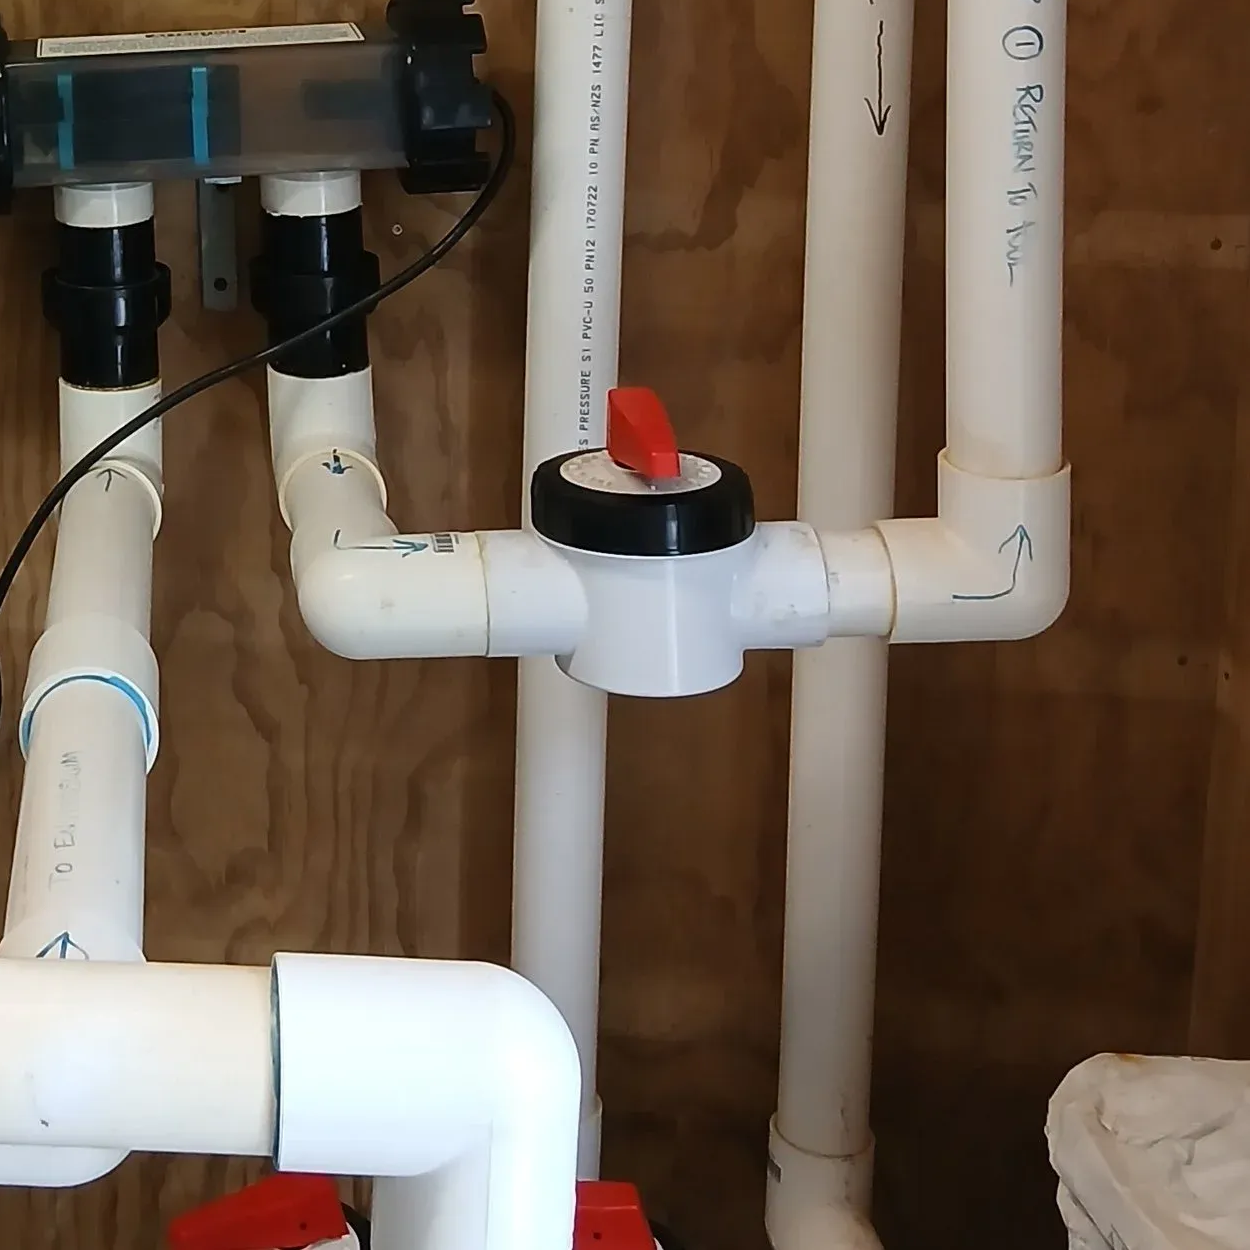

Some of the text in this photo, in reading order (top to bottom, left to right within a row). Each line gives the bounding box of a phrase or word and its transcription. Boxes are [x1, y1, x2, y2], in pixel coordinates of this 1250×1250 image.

[593, 13, 605, 37] LIC
[592, 44, 603, 73] 1477
[589, 84, 602, 131] AS/NZS
[588, 138, 600, 154] PN
[583, 277, 595, 293] 50
[582, 301, 594, 339] PVC-U
[579, 370, 592, 431] PRESSURE
